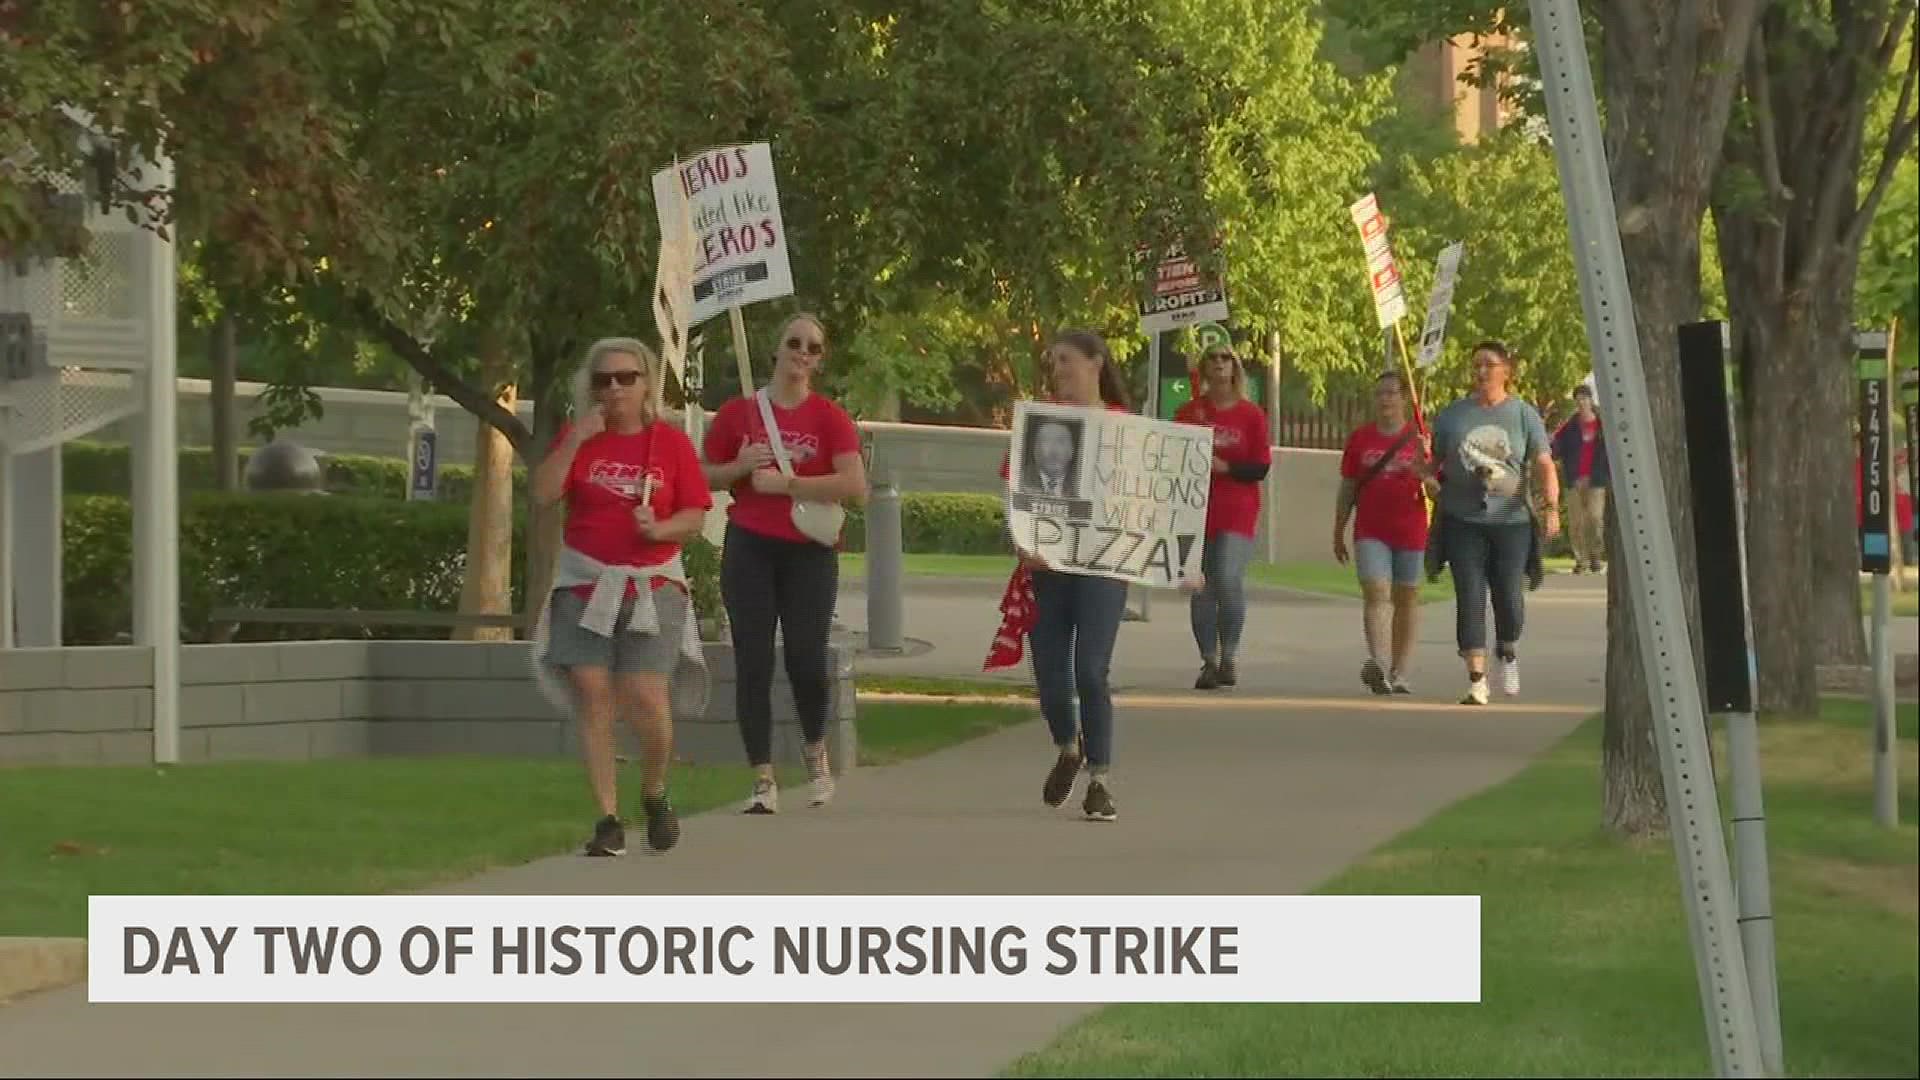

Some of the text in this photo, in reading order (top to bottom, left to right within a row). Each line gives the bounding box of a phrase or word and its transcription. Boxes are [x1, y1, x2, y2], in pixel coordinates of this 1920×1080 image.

[732, 190, 770, 219] like
[1143, 431, 1210, 476] GETS
[1868, 381, 1881, 515] 54750
[1095, 463, 1206, 510] MILLIONS
[1033, 516, 1196, 582] PIZZA!
